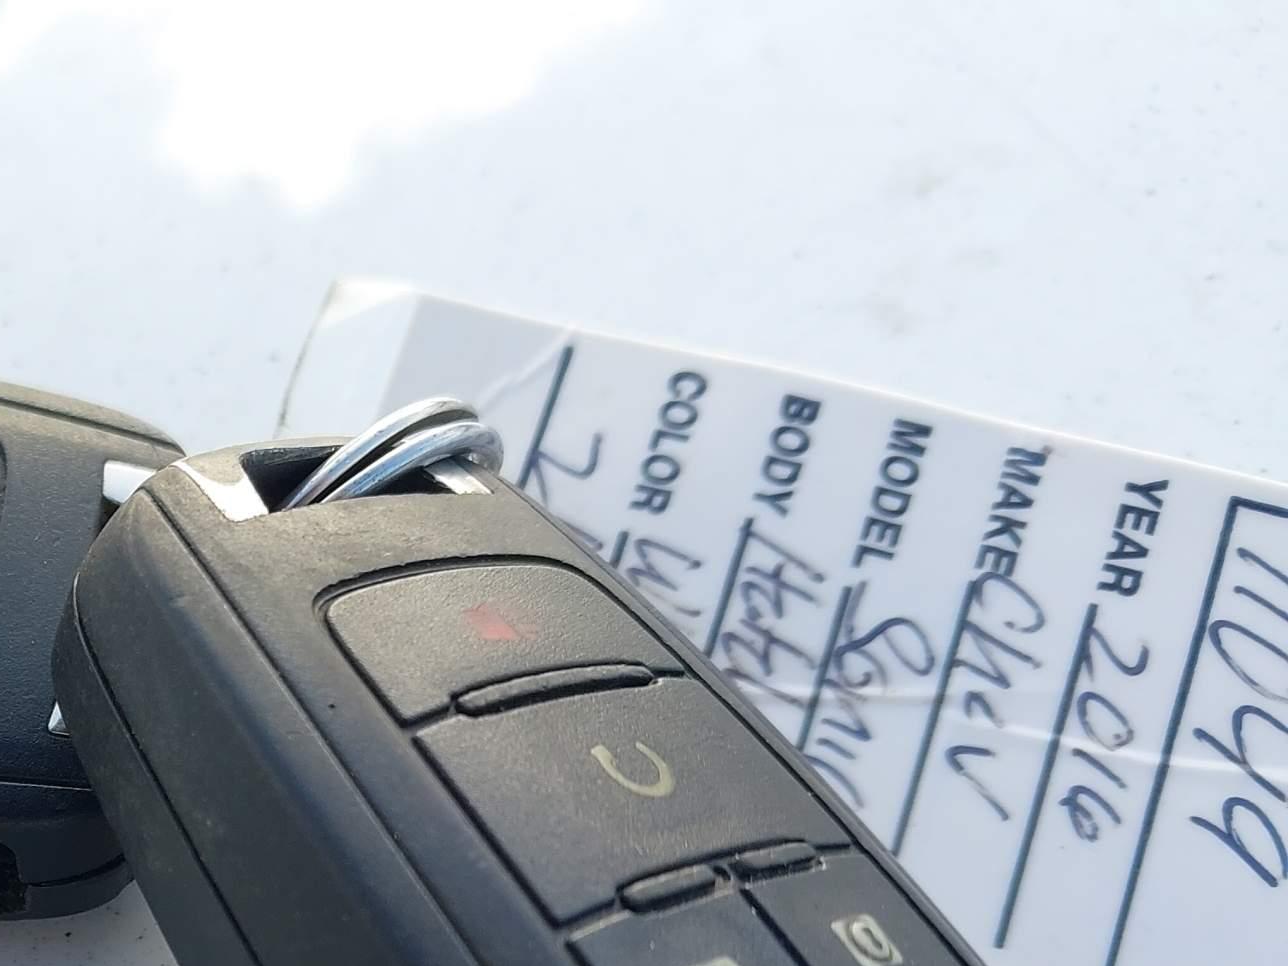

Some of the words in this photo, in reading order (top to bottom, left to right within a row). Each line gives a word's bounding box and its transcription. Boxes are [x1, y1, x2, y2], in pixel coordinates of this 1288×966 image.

[629, 369, 709, 515] COLOR
[752, 392, 822, 517] BODY
[850, 417, 933, 569] MODEL
[974, 446, 1048, 580] MAKE
[1096, 478, 1170, 598] YEAR
[1058, 625, 1150, 842] 2016
